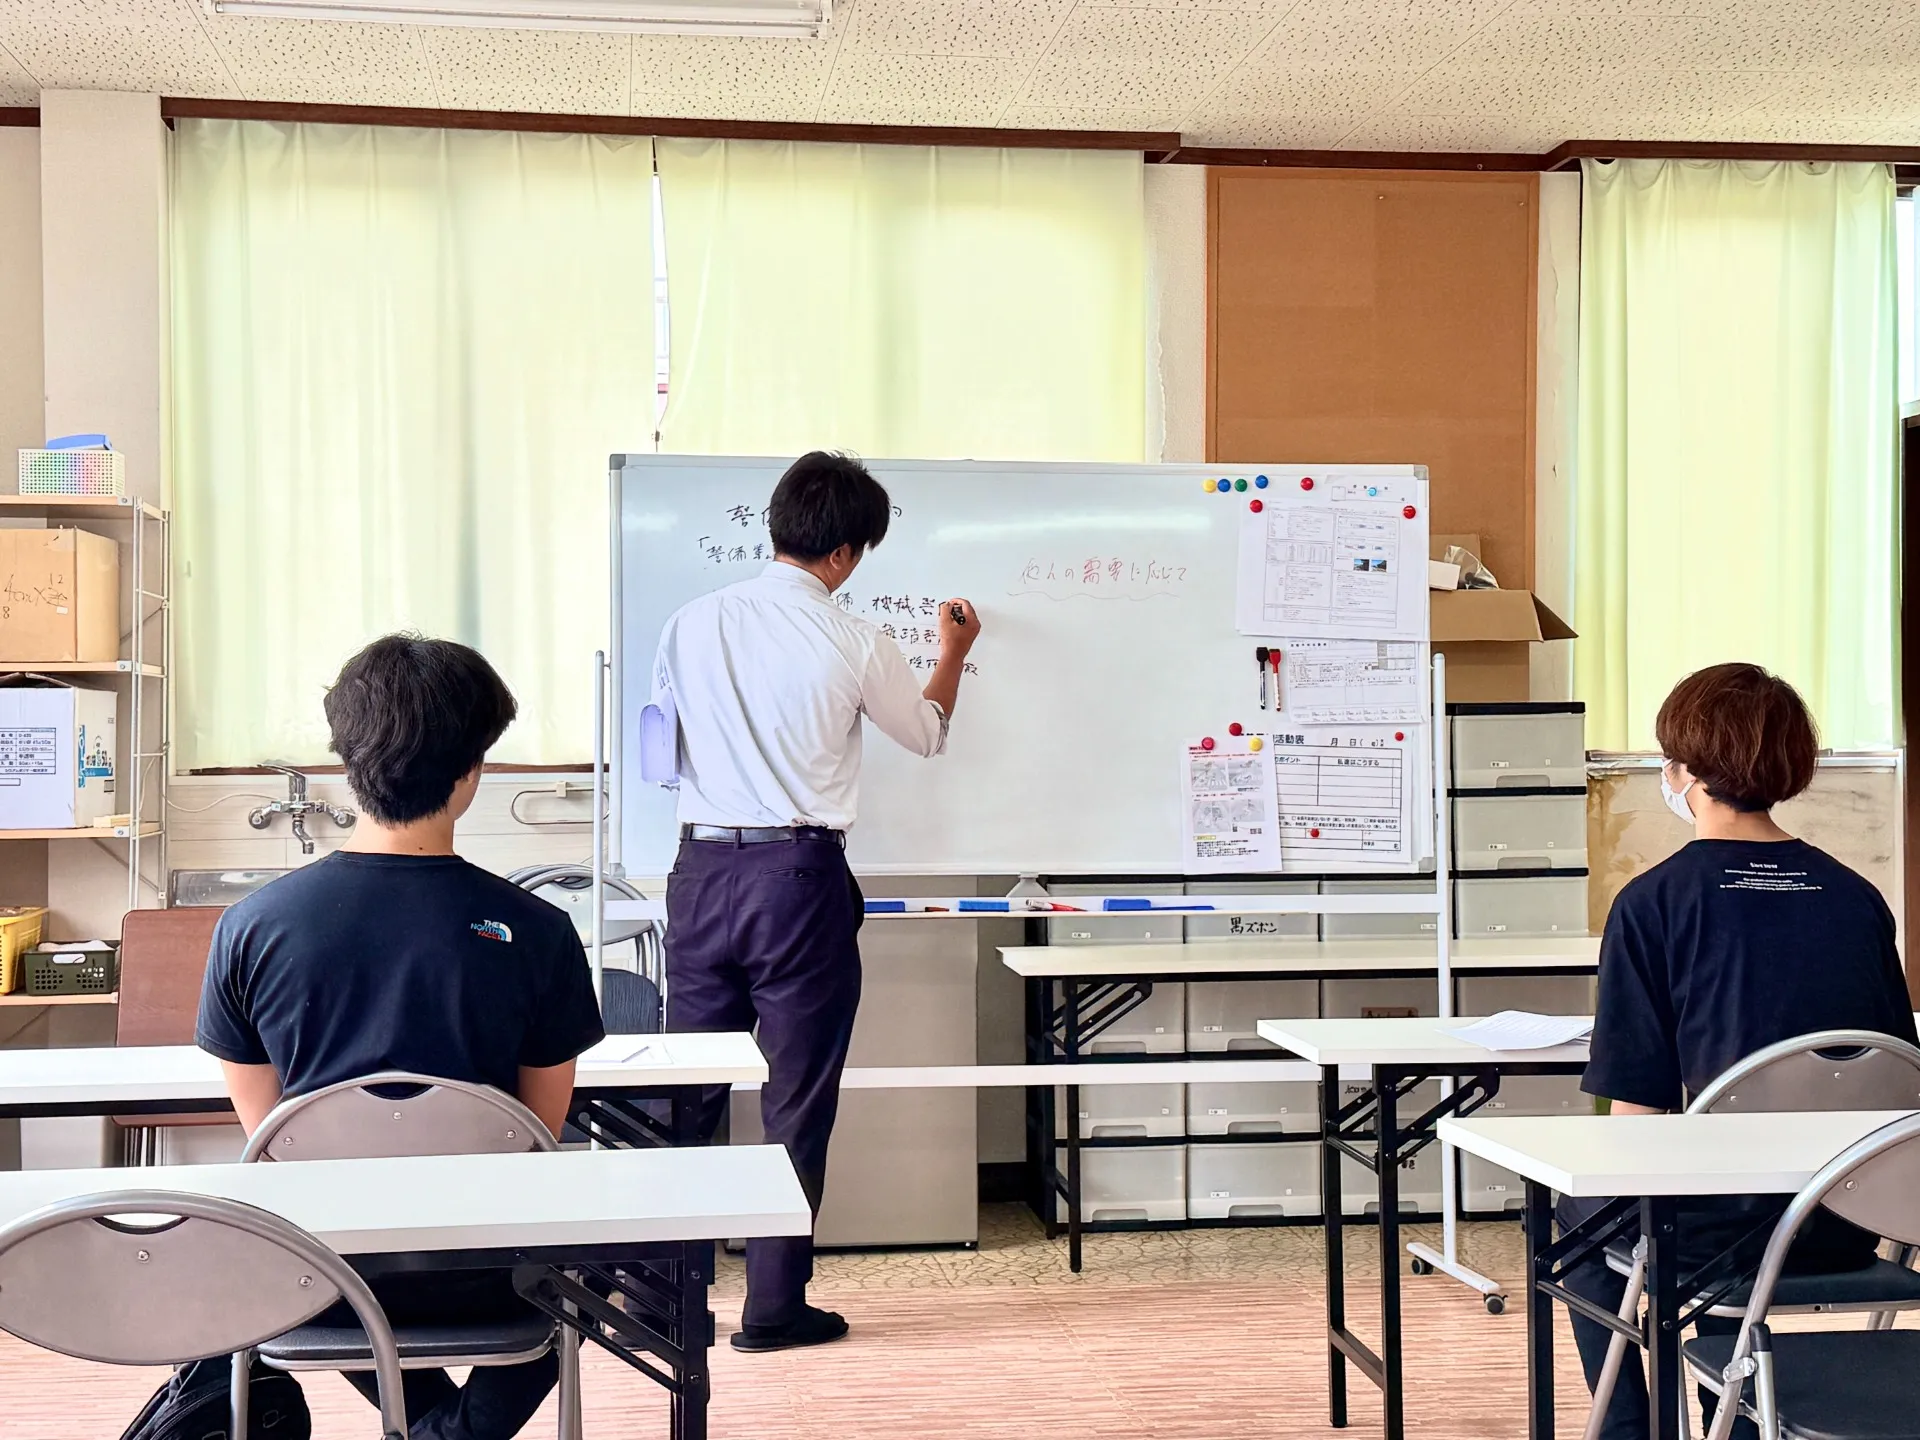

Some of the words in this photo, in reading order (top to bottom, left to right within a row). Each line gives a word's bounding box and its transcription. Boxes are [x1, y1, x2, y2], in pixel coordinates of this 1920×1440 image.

[470, 922, 498, 935] NORTH
[483, 919, 501, 929] THE
[1230, 916, 1277, 935] 黒ズボン
